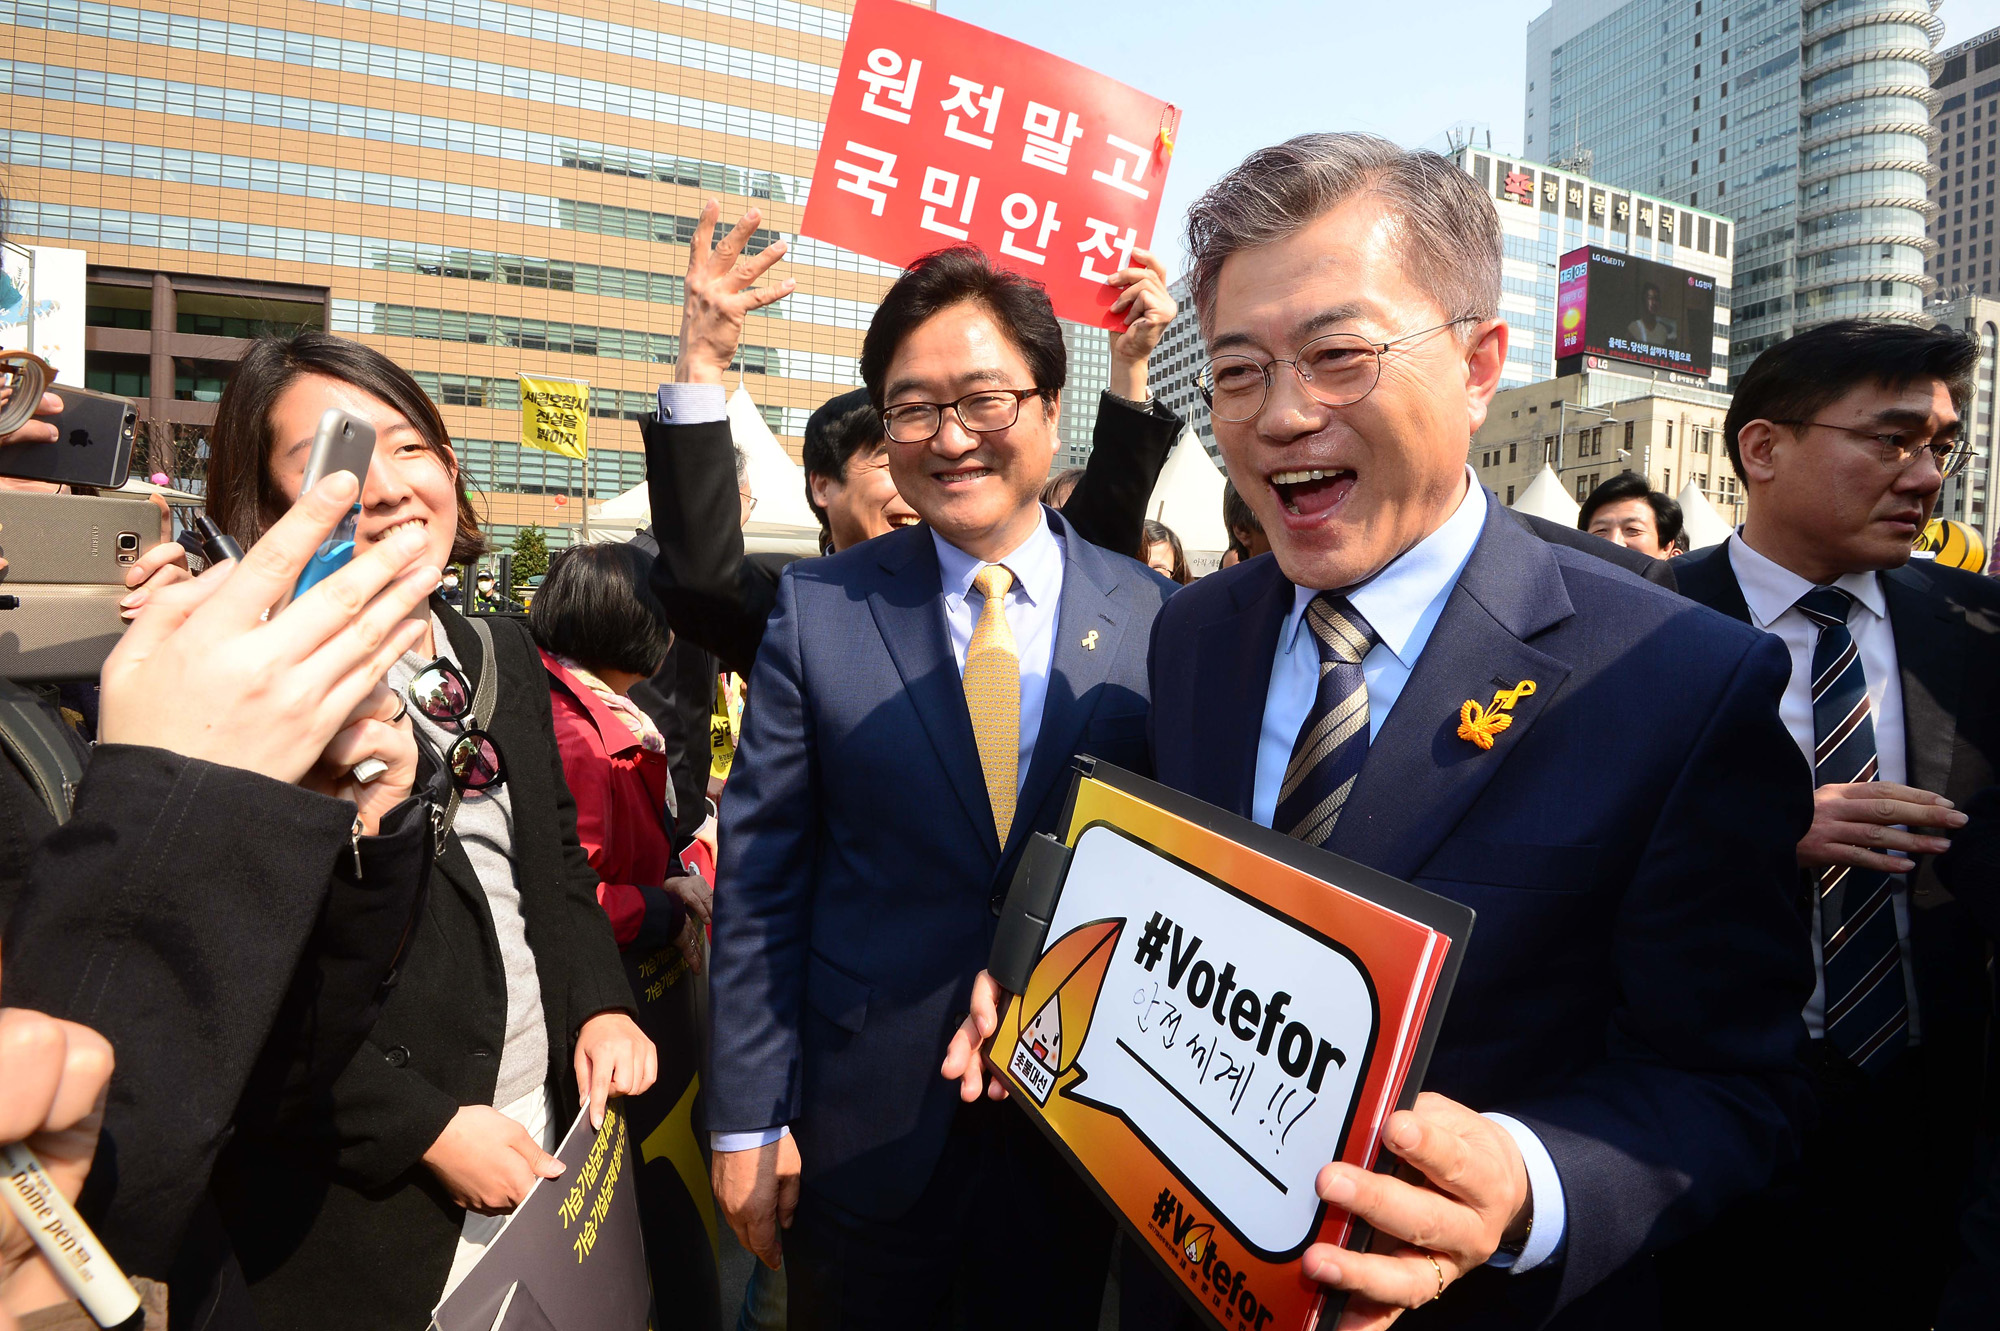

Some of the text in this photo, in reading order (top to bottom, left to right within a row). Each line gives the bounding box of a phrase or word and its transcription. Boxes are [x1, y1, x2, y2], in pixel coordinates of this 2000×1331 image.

[1961, 29, 1999, 51] CENTE
[1543, 181, 1674, 233] 광화문우체국
[1592, 252, 1600, 262] LG
[1597, 358, 1608, 370] LG
[536, 408, 578, 429] 진실을
[1133, 910, 1347, 1095] #Votefor
[558, 1127, 608, 1229] 가습기살균제
[11, 1170, 53, 1220] name
[42, 1218, 77, 1252] pen
[573, 1159, 618, 1264] 가습기살균제
